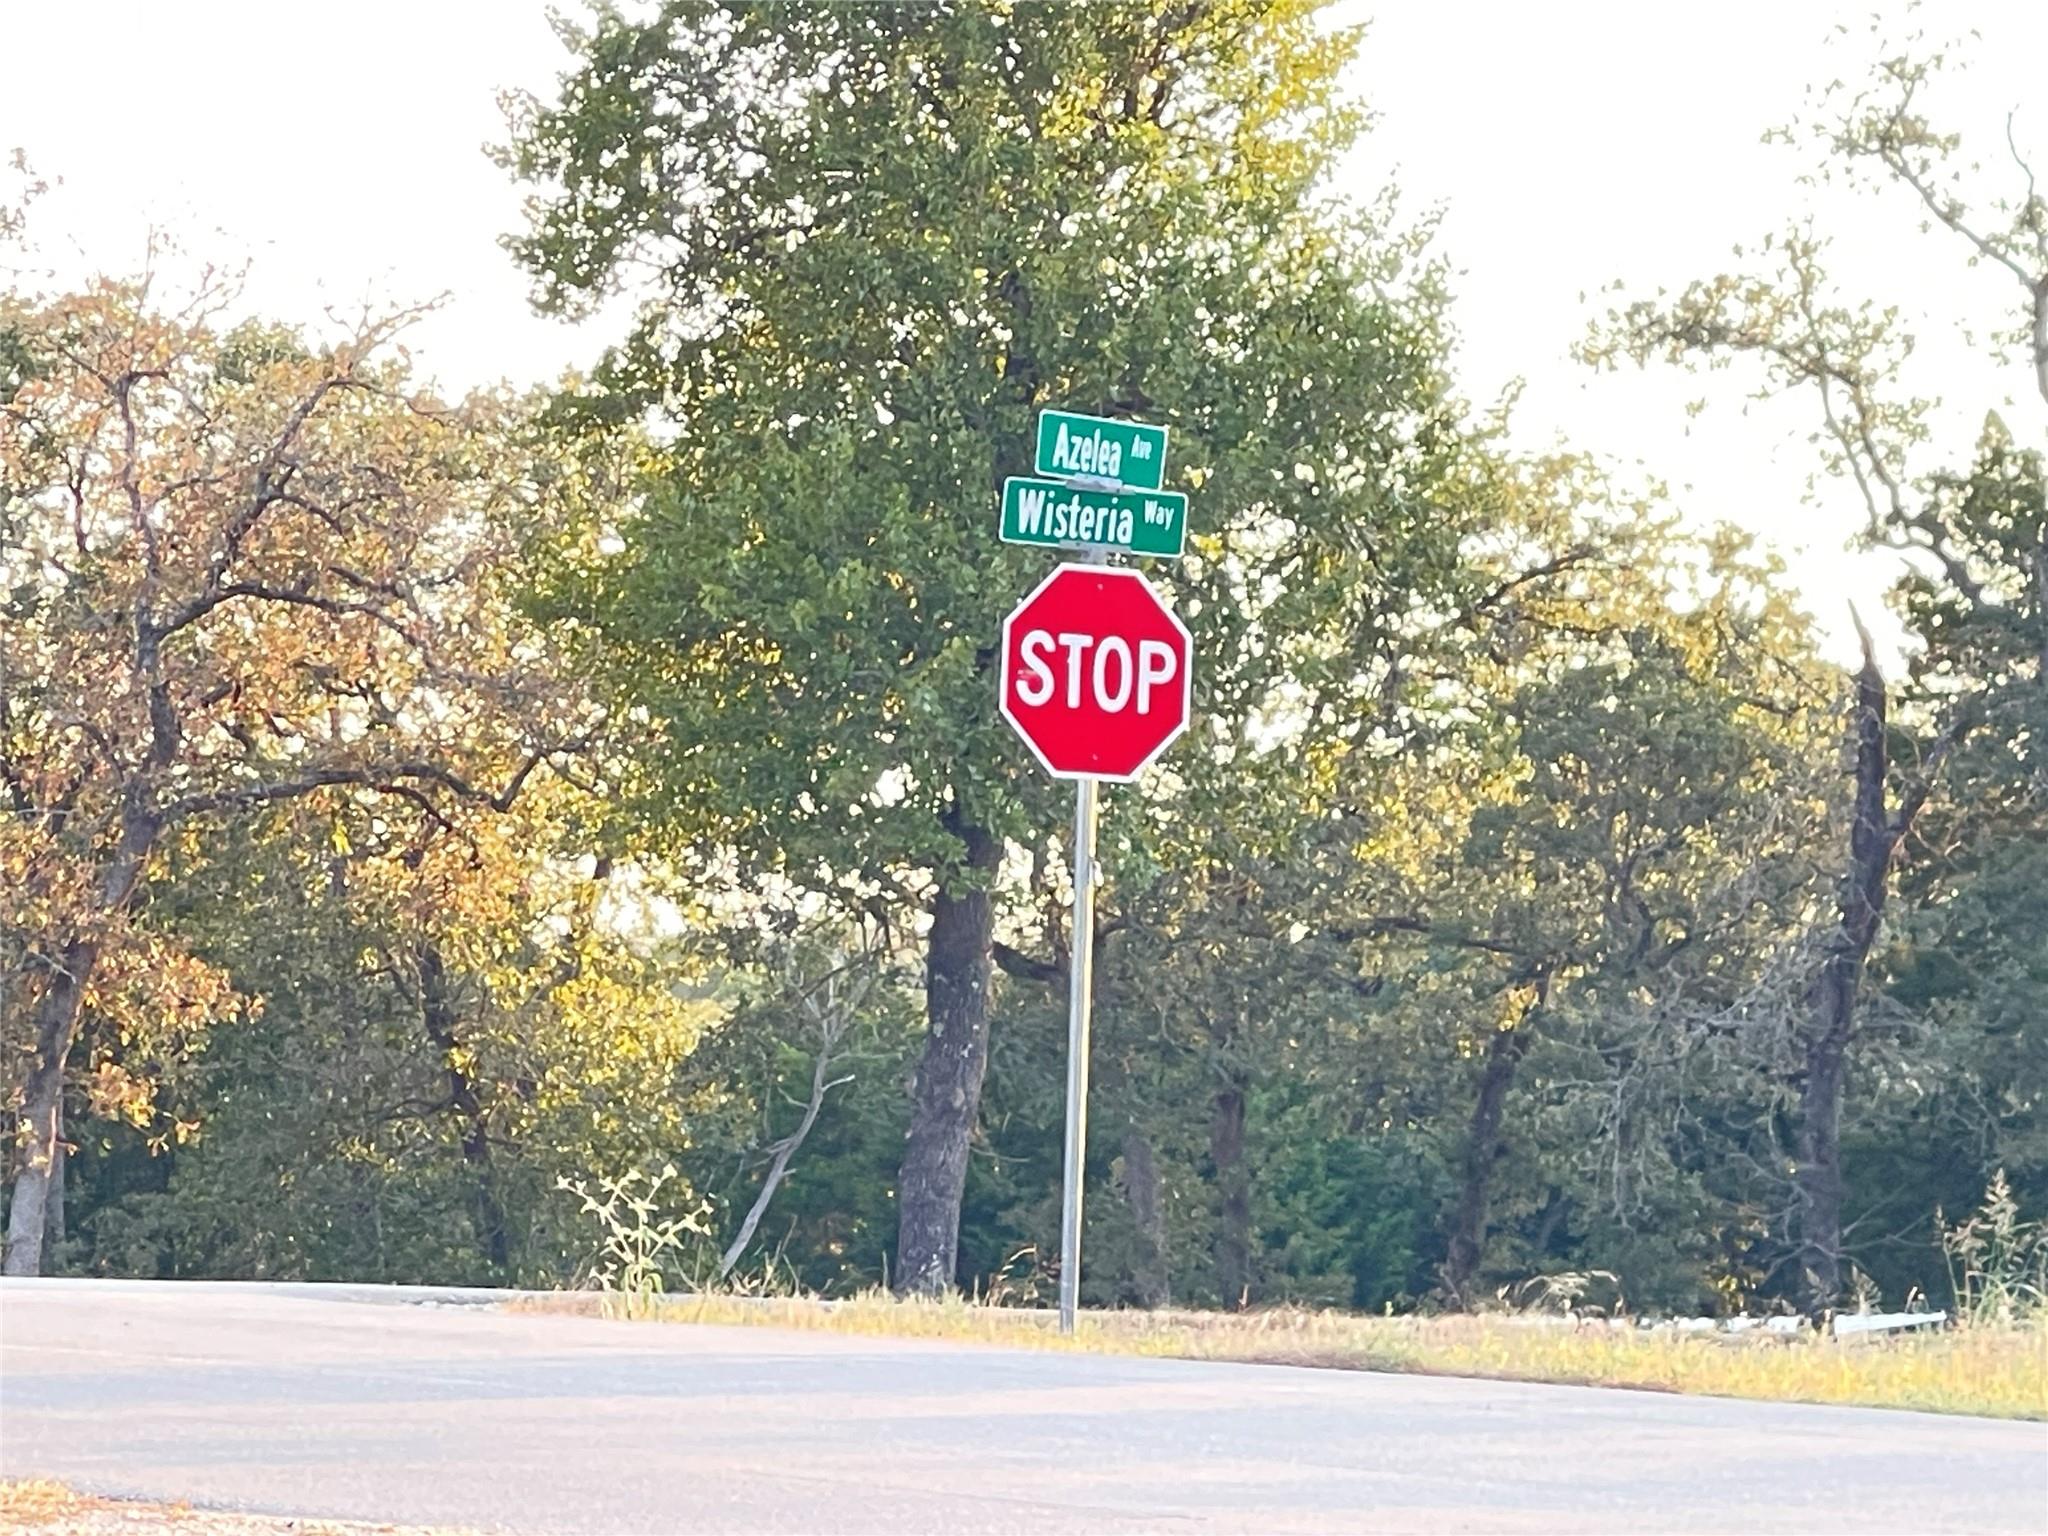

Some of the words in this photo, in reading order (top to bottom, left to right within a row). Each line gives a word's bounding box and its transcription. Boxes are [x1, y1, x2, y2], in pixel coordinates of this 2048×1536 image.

[1052, 422, 1122, 476] Azelea
[1131, 434, 1153, 460] Ave
[1018, 488, 1134, 544] Wisteria
[1144, 500, 1175, 531] Way
[1015, 629, 1177, 715] STOP
